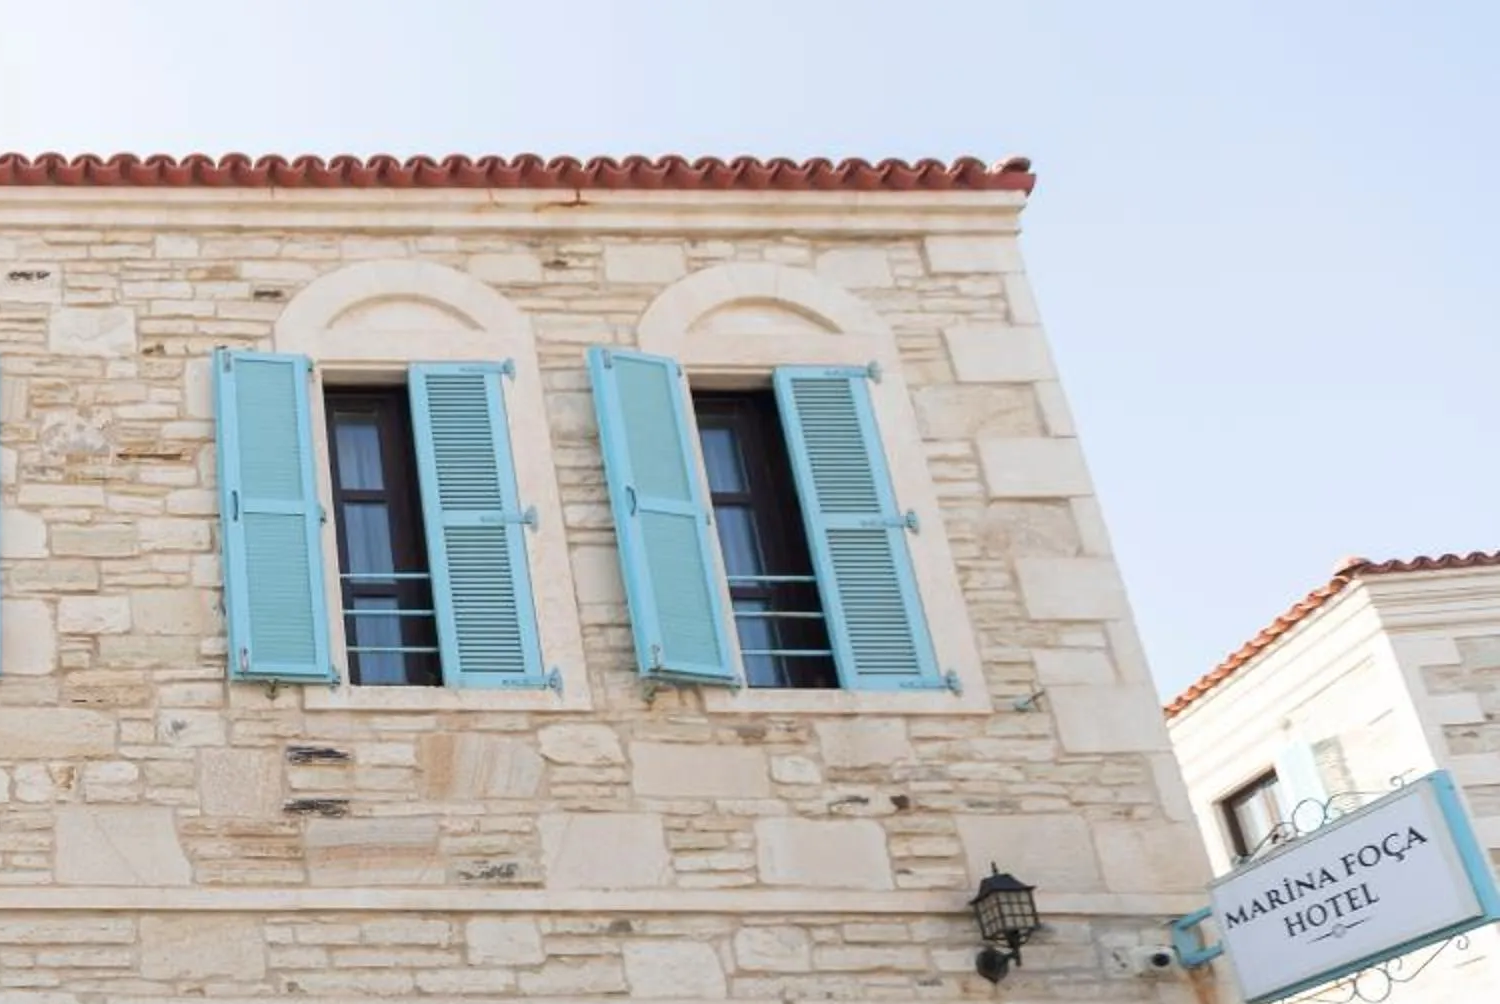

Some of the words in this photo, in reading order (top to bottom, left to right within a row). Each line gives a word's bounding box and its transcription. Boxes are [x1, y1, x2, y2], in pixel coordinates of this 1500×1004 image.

[1225, 867, 1337, 929] MARİNA
[1340, 826, 1428, 877] FOÇA
[1283, 882, 1380, 937] HOTEL
